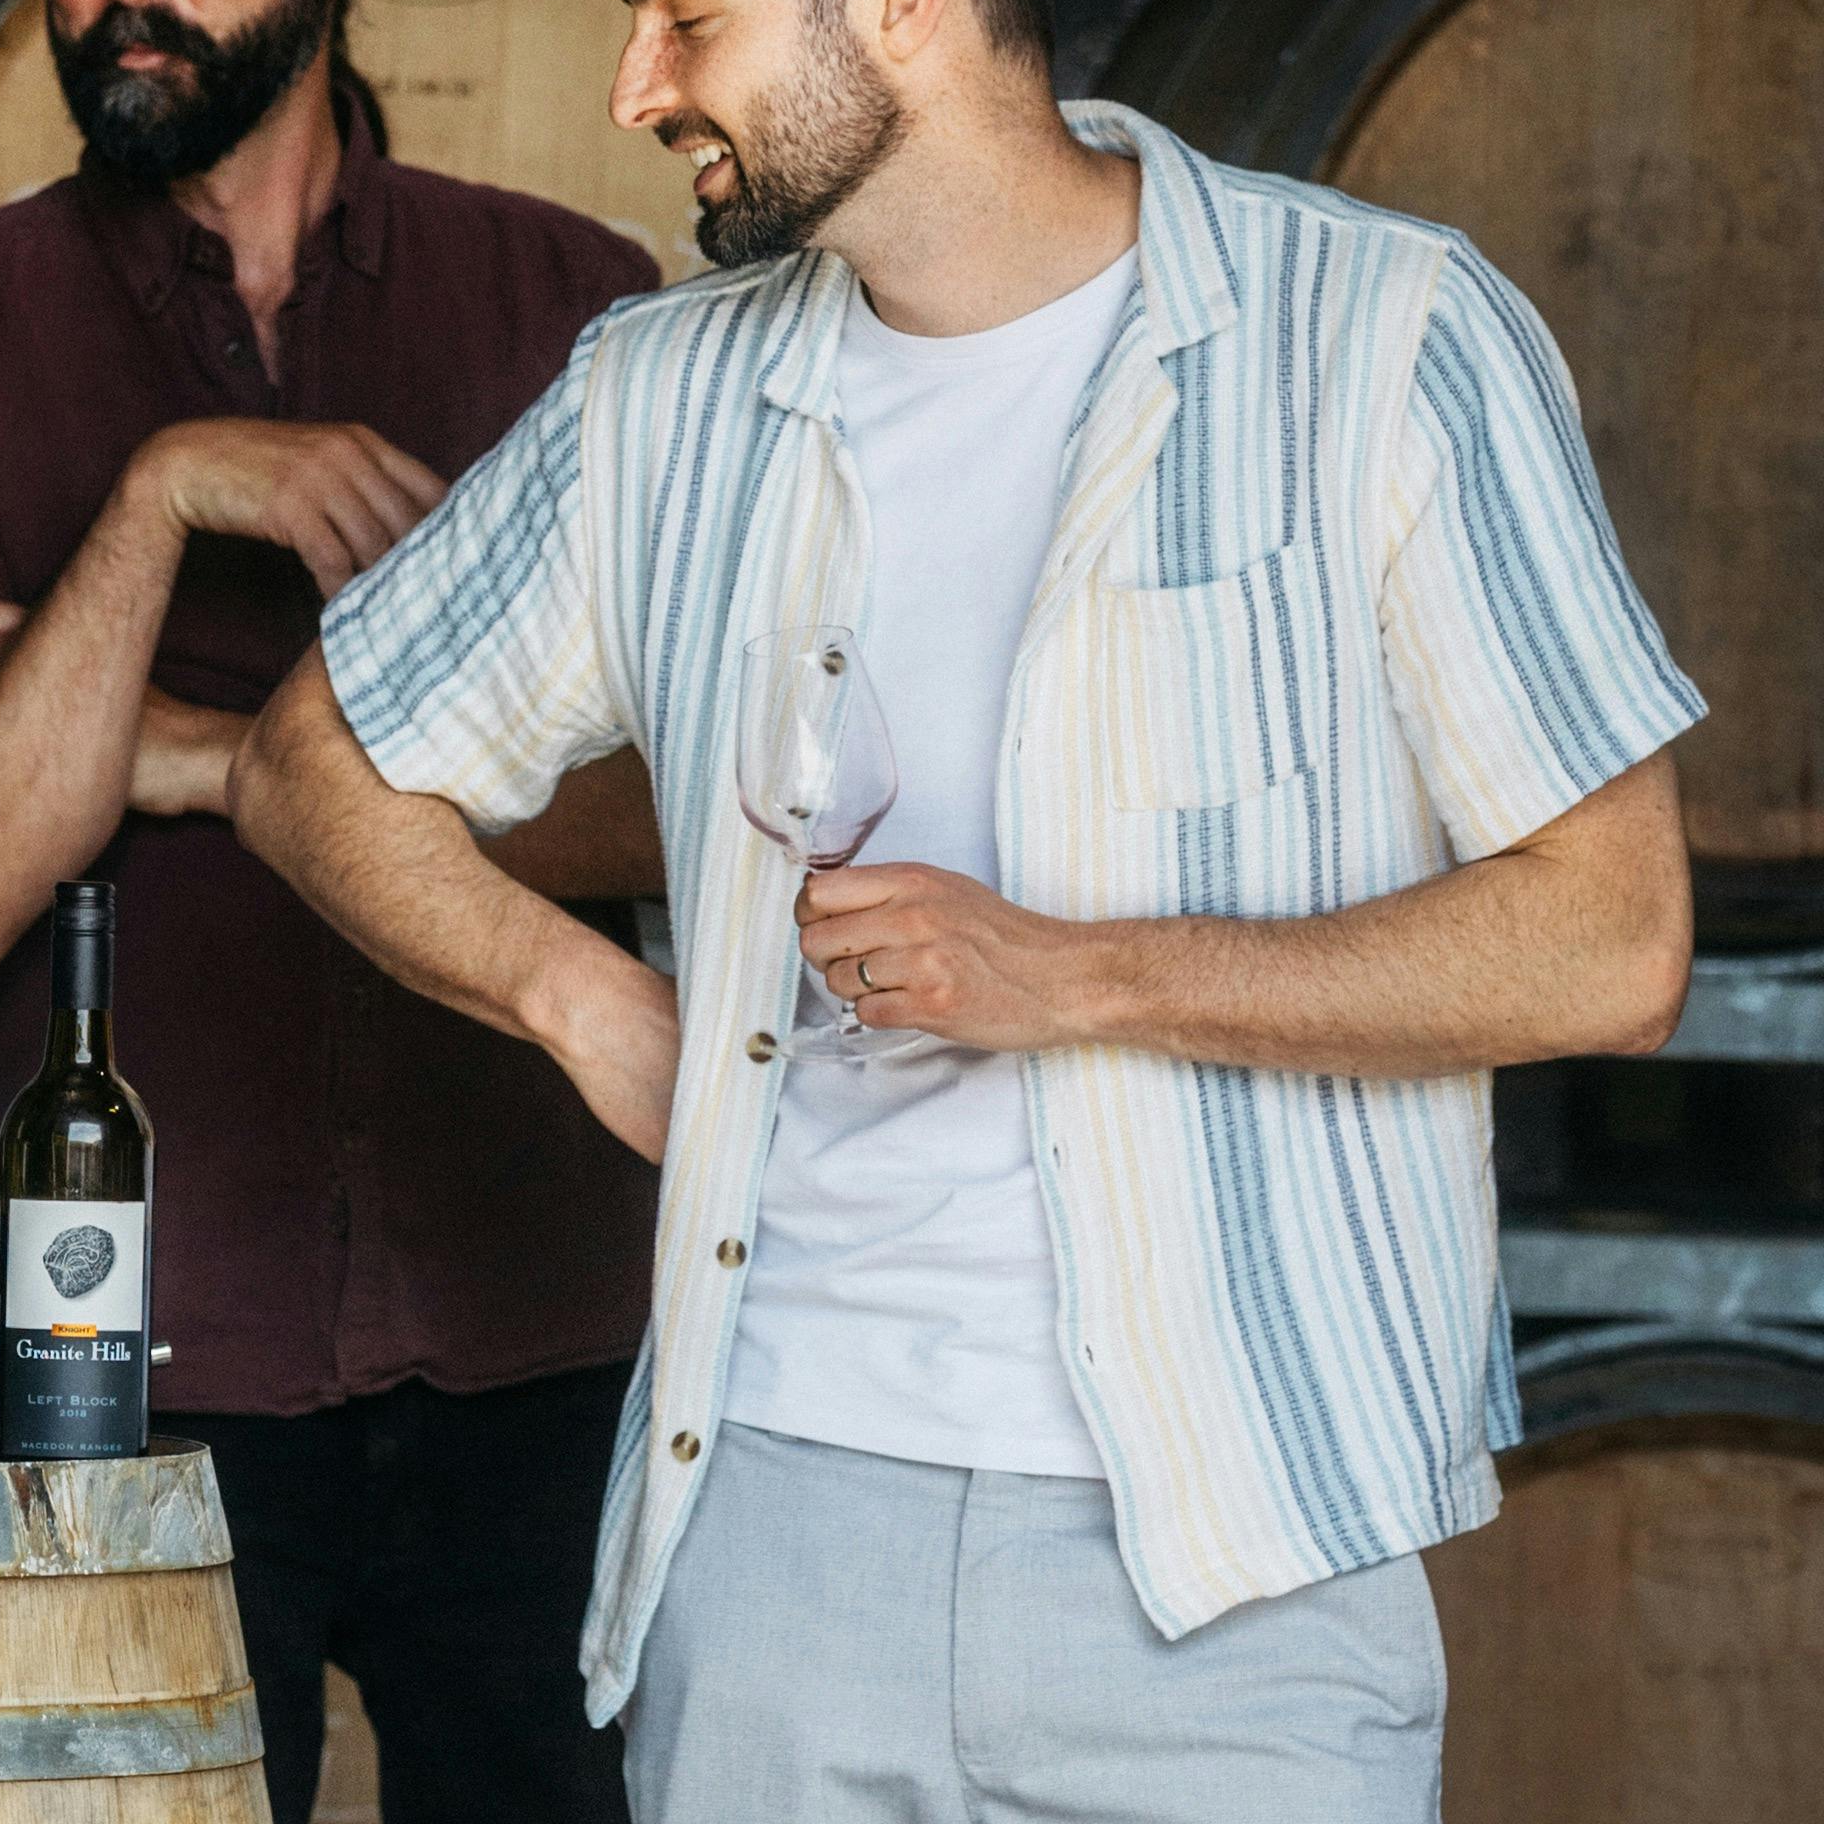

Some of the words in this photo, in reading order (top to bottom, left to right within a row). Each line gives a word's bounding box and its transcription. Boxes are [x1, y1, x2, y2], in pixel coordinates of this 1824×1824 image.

[58, 1325, 91, 1334] KNIGHT
[16, 1339, 85, 1361] Granite
[91, 1341, 131, 1361] Hills
[28, 1394, 63, 1406] LEFT
[70, 1395, 118, 1406] BLOCK
[59, 1409, 87, 1418] 2018
[21, 1441, 73, 1451] MACEDON
[79, 1442, 123, 1452] RANGES
